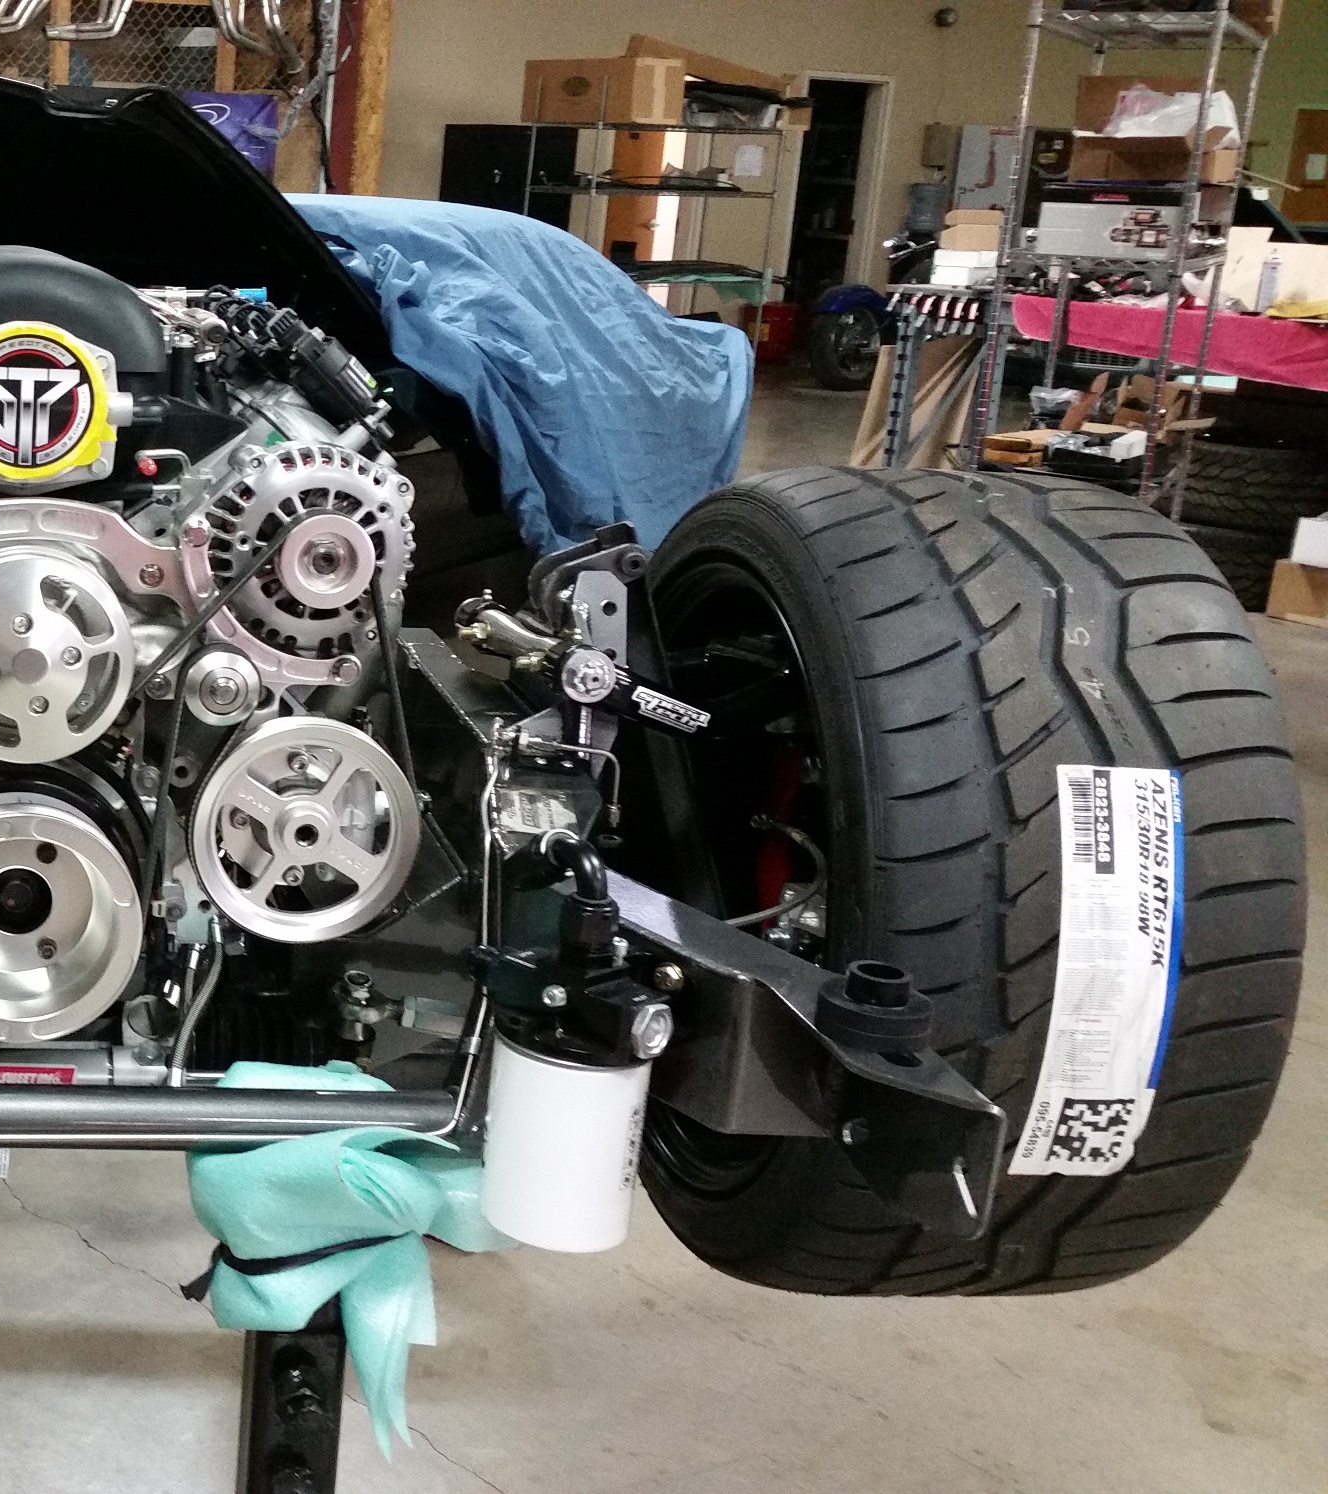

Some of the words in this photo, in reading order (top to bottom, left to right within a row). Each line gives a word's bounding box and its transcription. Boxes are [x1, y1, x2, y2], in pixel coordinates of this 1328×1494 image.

[1094, 777, 1112, 864] 2823-3848
[1134, 779, 1151, 885] 315/30R18
[1150, 778, 1169, 869] AZENIS
[1151, 874, 1170, 969] RT615K
